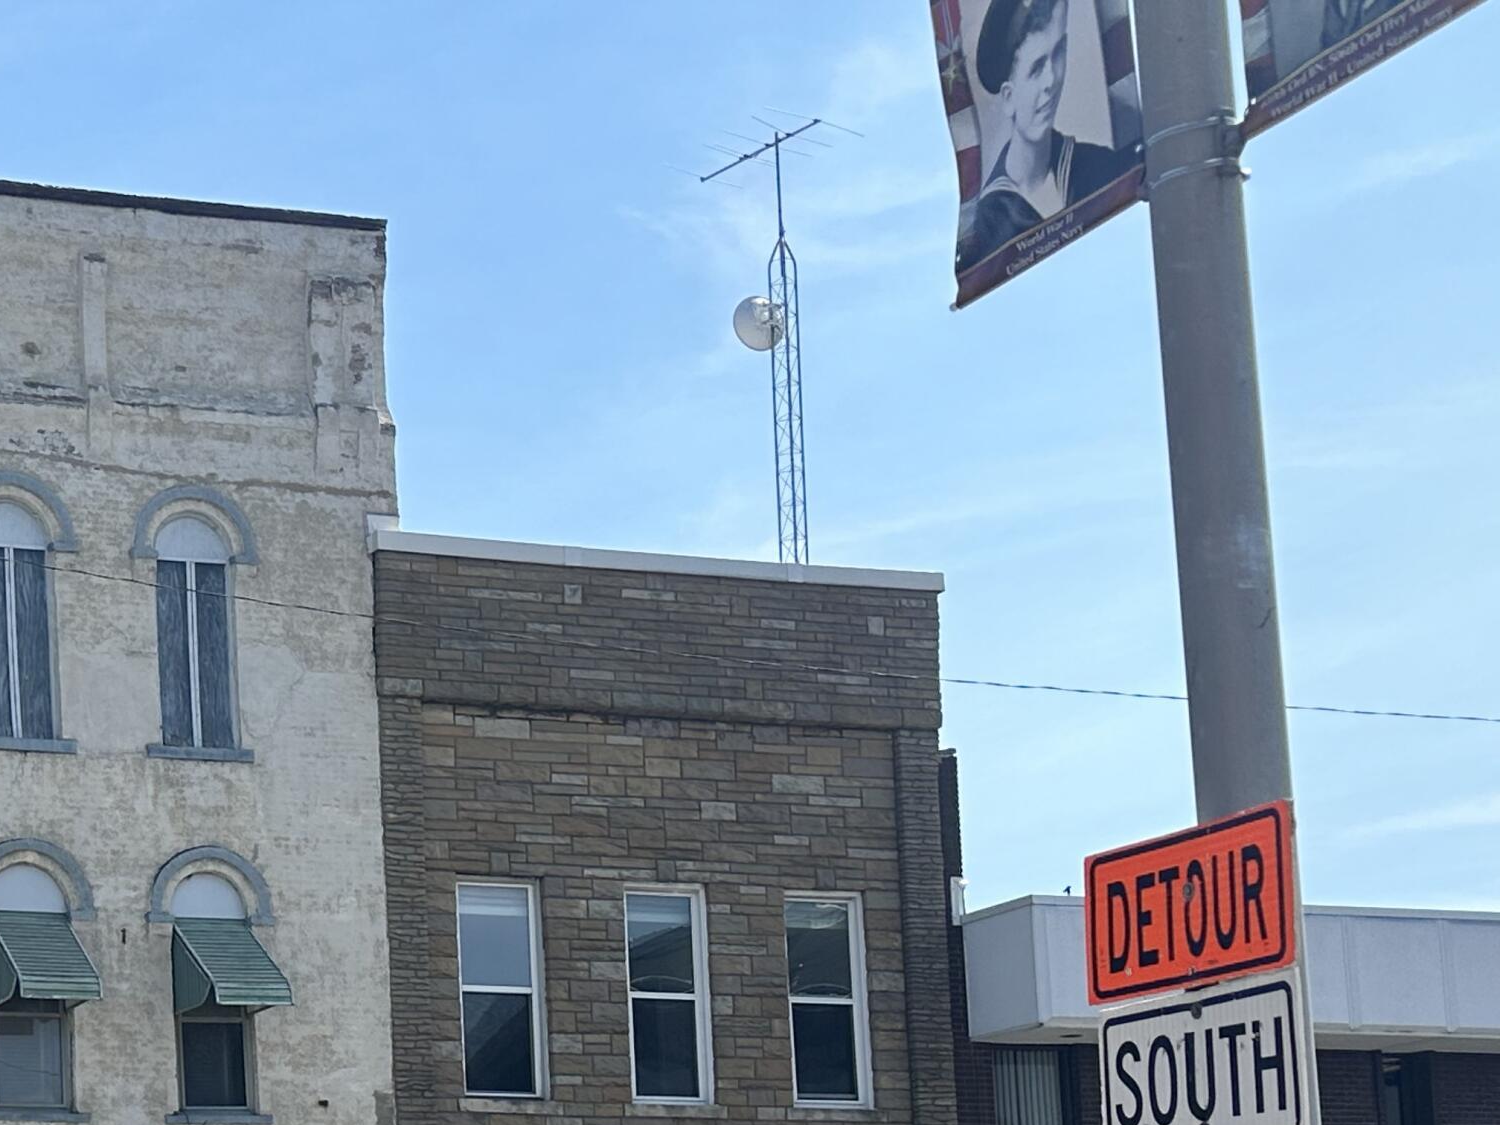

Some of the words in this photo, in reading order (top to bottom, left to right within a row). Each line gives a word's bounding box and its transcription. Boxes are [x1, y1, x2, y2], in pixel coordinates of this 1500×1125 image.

[1271, 91, 1304, 117] World
[1304, 80, 1327, 99] War
[1346, 43, 1385, 74] United
[1385, 25, 1420, 47] States
[1423, 4, 1453, 27] Army
[1006, 250, 1035, 276] United
[1035, 239, 1061, 255] States
[1061, 223, 1084, 240] Navy
[1016, 228, 1046, 252] World
[1046, 219, 1065, 236] War
[1107, 843, 1268, 974] DETOUR
